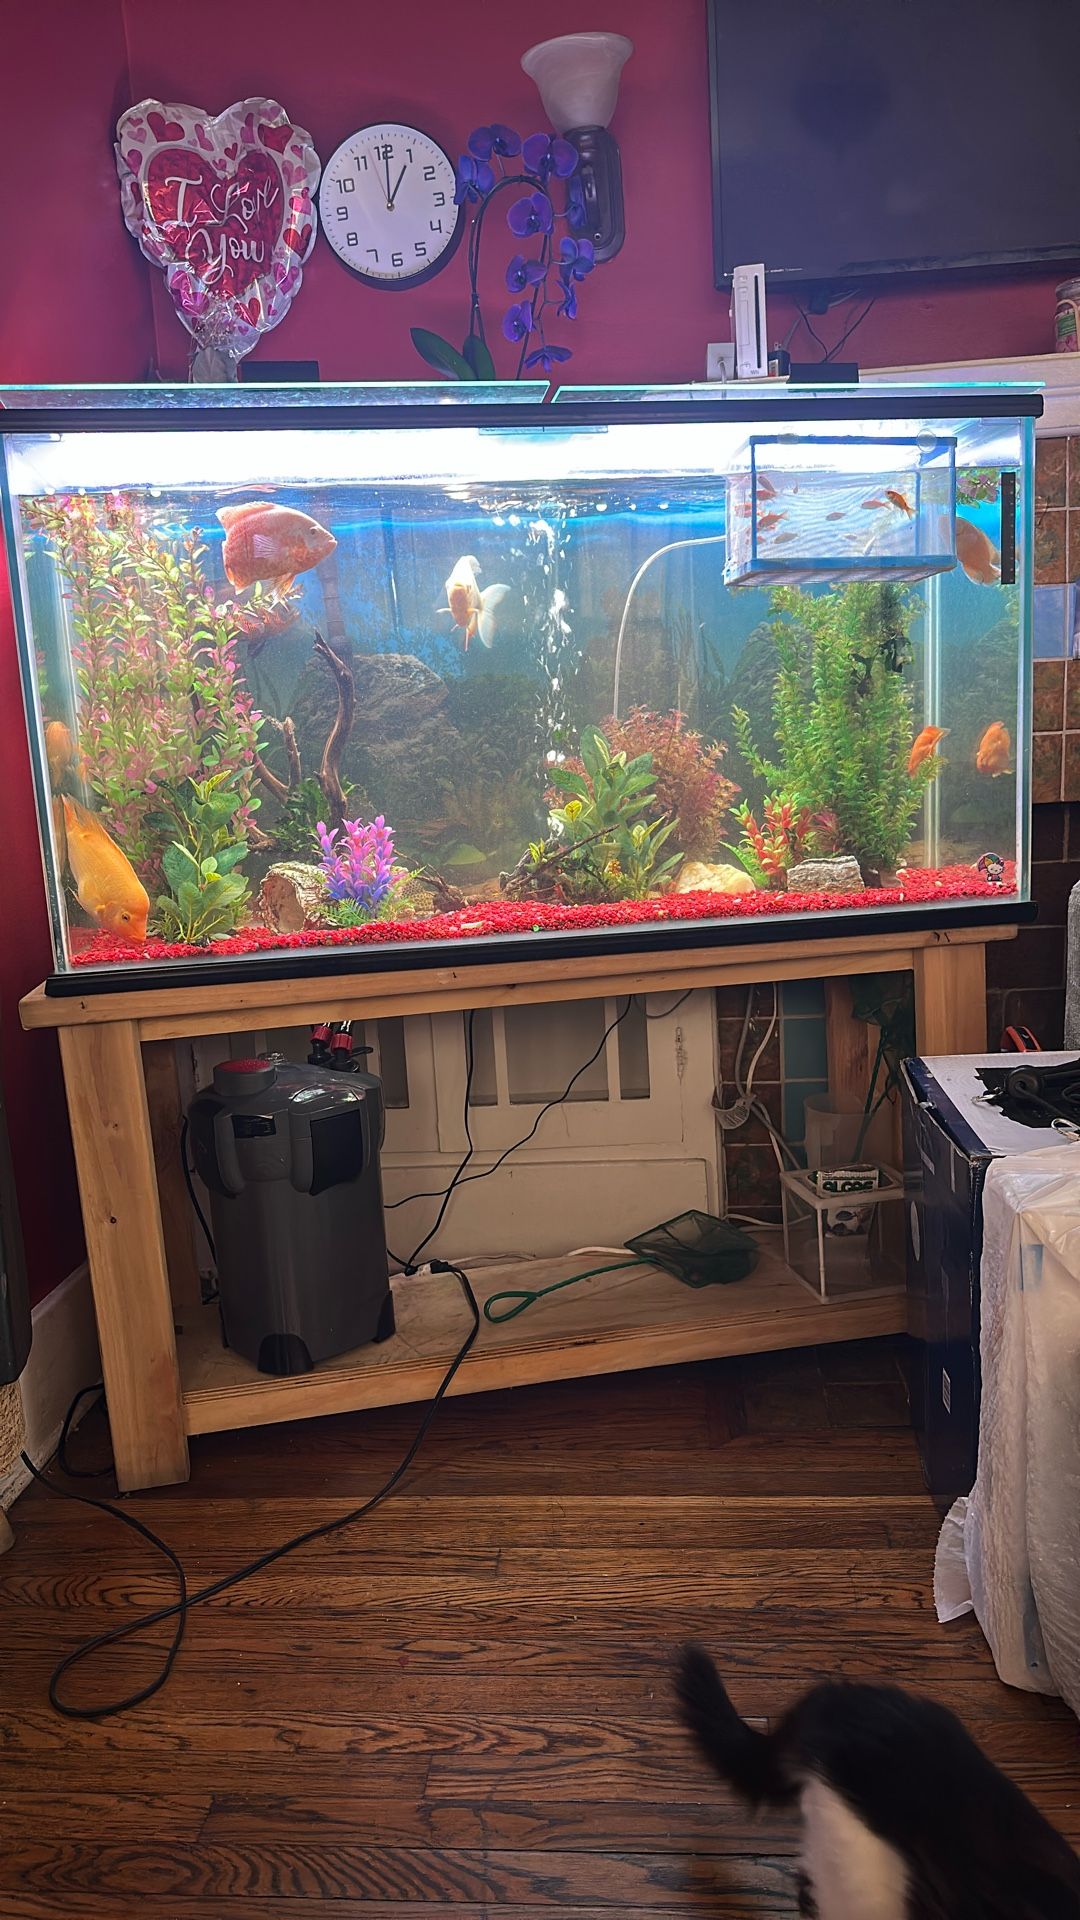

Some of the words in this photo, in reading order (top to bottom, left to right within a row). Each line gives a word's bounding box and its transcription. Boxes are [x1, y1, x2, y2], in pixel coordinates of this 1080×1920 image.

[374, 143, 394, 160] 12
[406, 149, 413, 163] 1
[354, 156, 368, 171] 11
[423, 165, 436, 181] 2
[336, 178, 355, 193] 10
[163, 175, 203, 228] I
[205, 176, 280, 234] Love
[433, 192, 446, 207] 3
[337, 206, 349, 221] 9
[430, 219, 442, 234] 4
[347, 232, 358, 247] 8
[185, 228, 265, 285] You
[366, 249, 379, 263] 7
[414, 241, 427, 257] 5
[391, 252, 404, 267] 6
